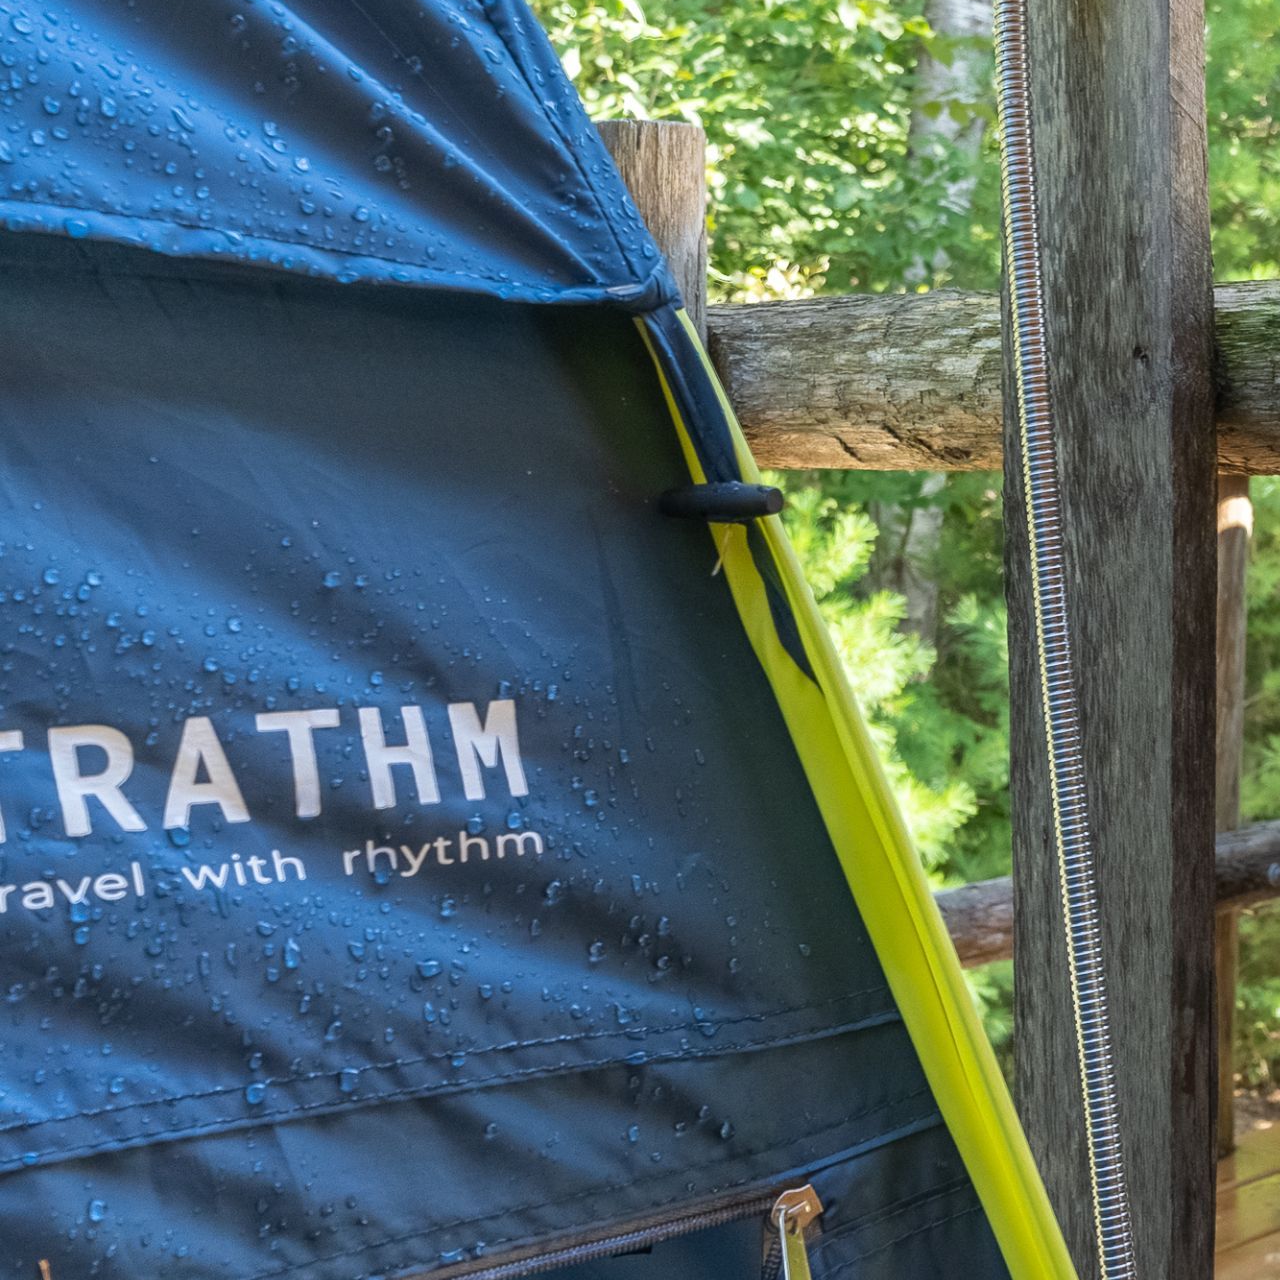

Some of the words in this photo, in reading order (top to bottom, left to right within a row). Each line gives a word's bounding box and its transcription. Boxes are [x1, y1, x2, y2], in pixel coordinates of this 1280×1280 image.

[0, 699, 529, 843] RATHM
[182, 849, 306, 891] with
[343, 830, 543, 878] rhythm
